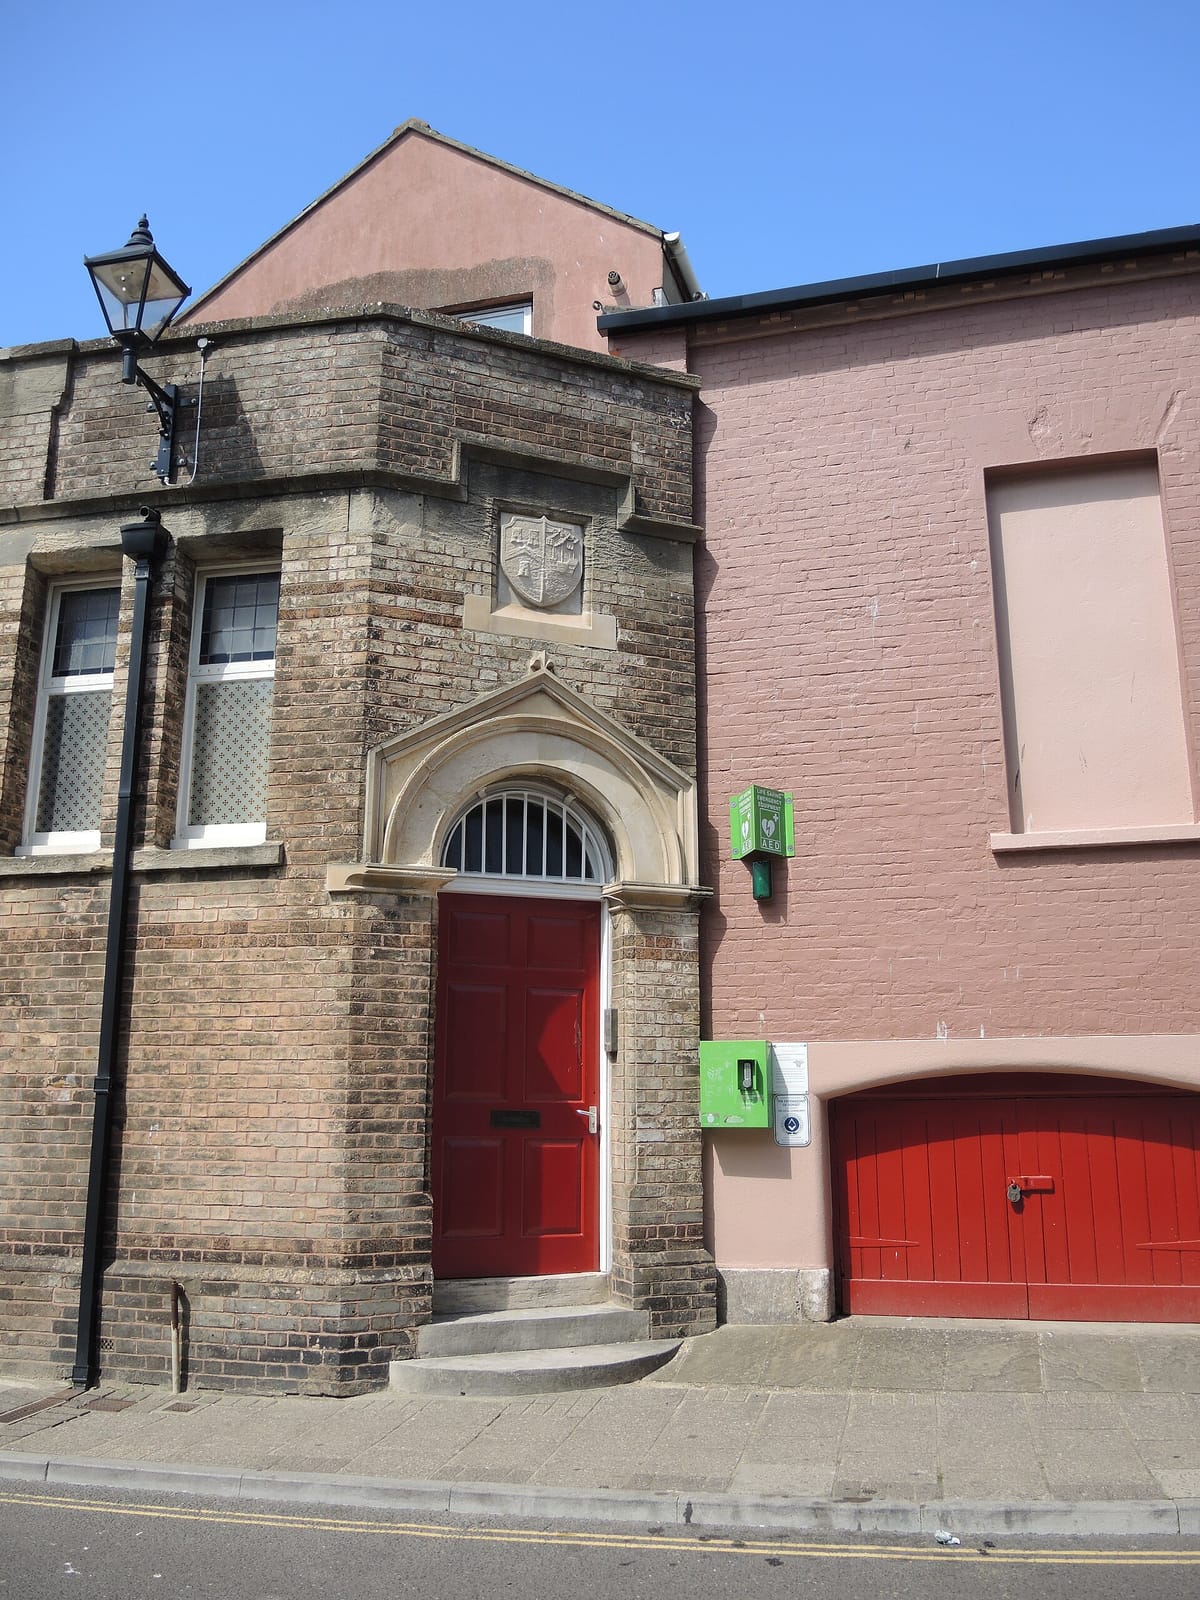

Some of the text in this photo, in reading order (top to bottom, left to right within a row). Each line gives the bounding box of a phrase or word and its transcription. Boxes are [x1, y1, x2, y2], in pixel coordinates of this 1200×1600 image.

[757, 794, 782, 806] EMERGENCY
[758, 801, 781, 812] EQUIPMENT
[762, 840, 780, 850] AED
